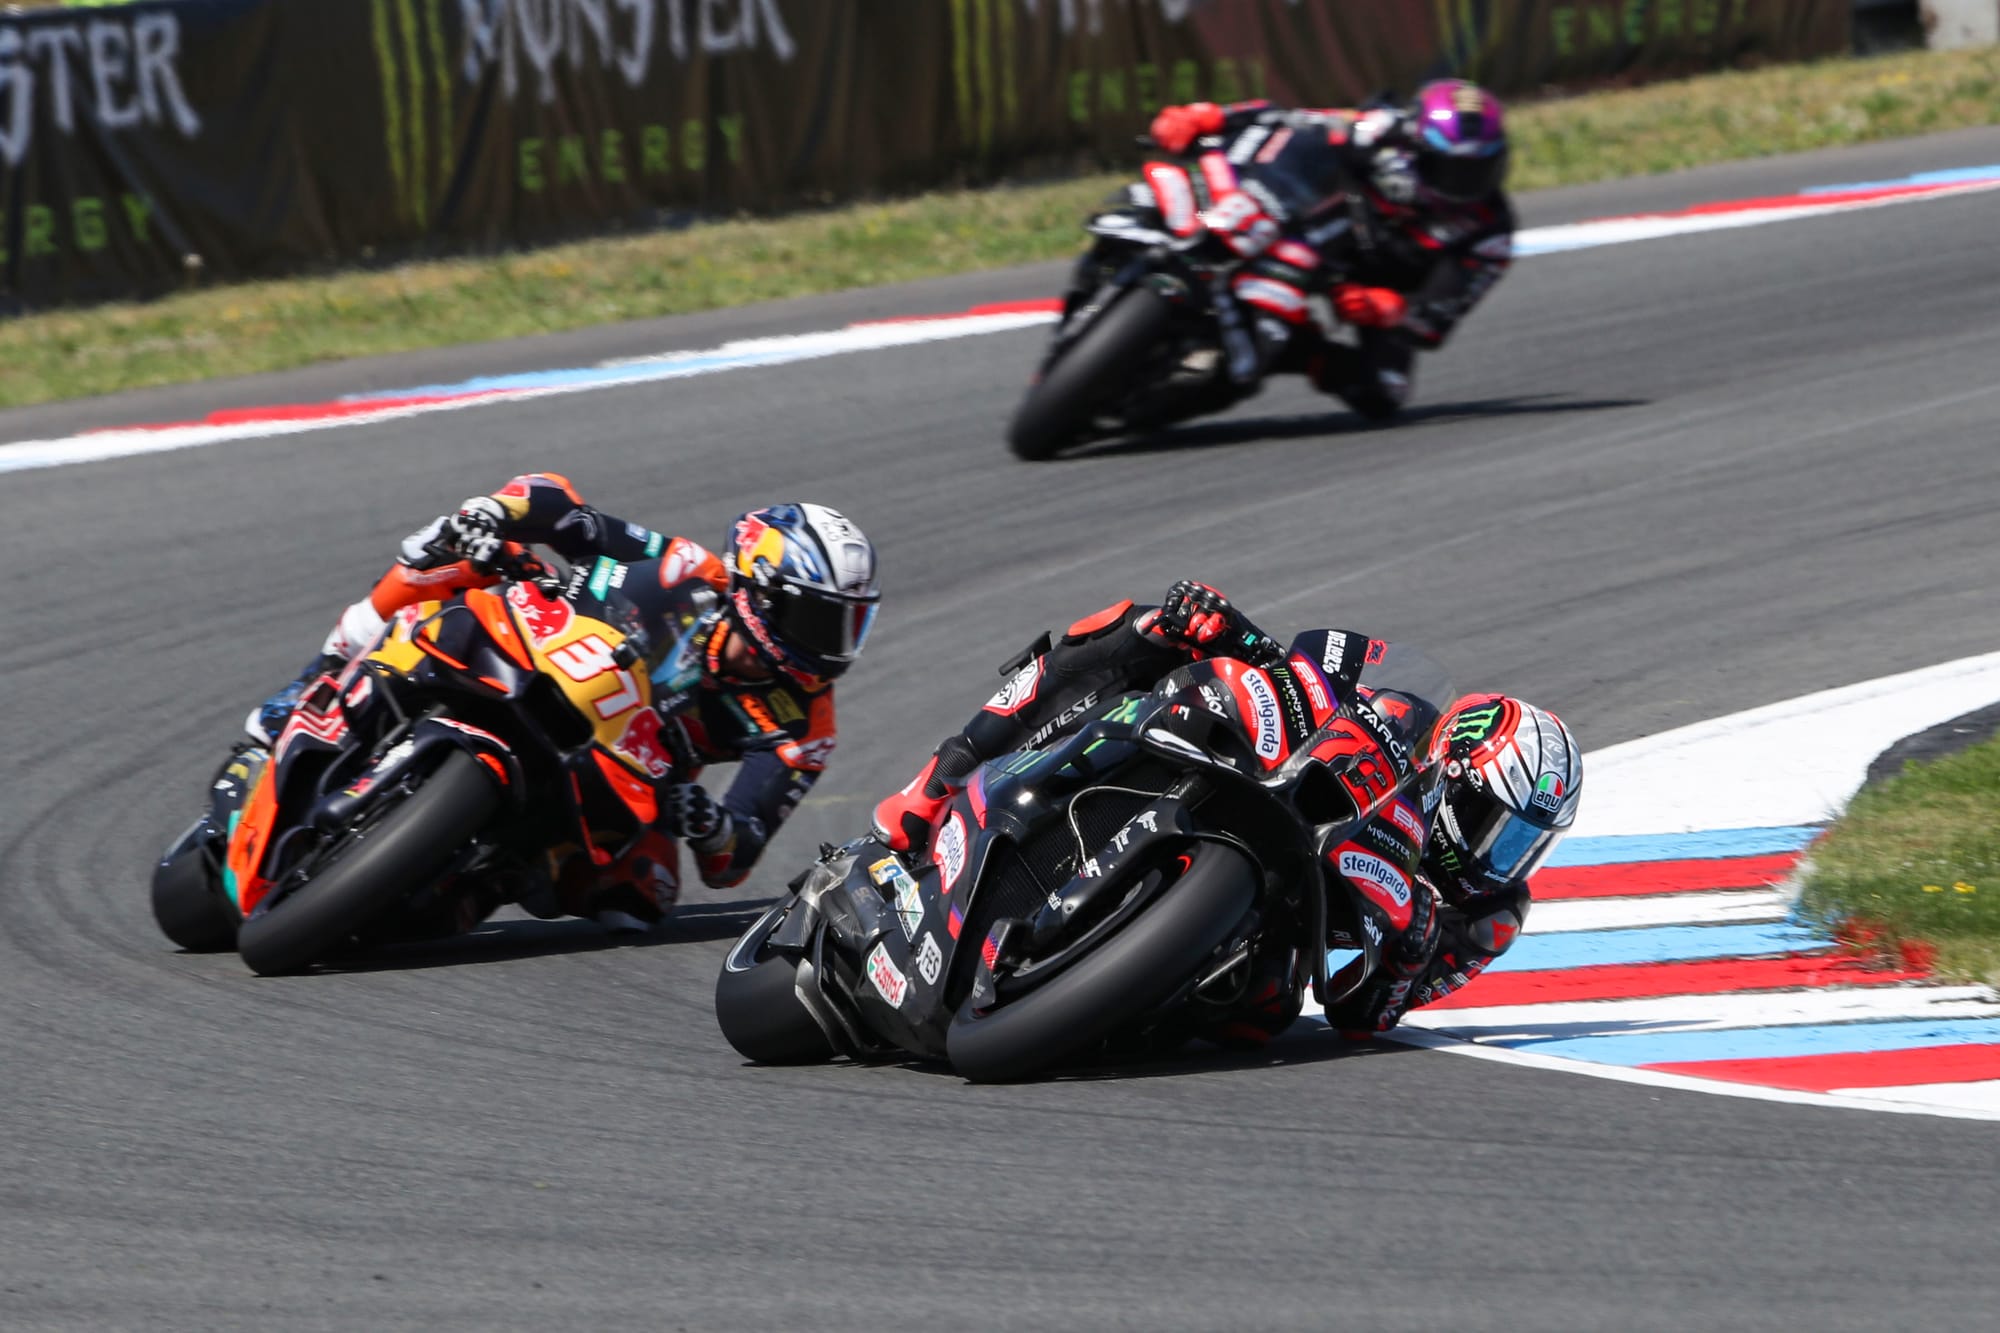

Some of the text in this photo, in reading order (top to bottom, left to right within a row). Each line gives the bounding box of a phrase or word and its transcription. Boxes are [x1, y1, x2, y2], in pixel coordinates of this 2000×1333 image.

[519, 113, 744, 192] ENERGY
[0, 193, 152, 264] RGY
[1246, 673, 1279, 754] sterilgarda
[1284, 678, 1308, 739] MONSTER
[1536, 790, 1560, 809] agv
[1367, 824, 1411, 861] MONSTER
[1343, 854, 1408, 901] sterilgarda
[1363, 915, 1383, 946] sky
